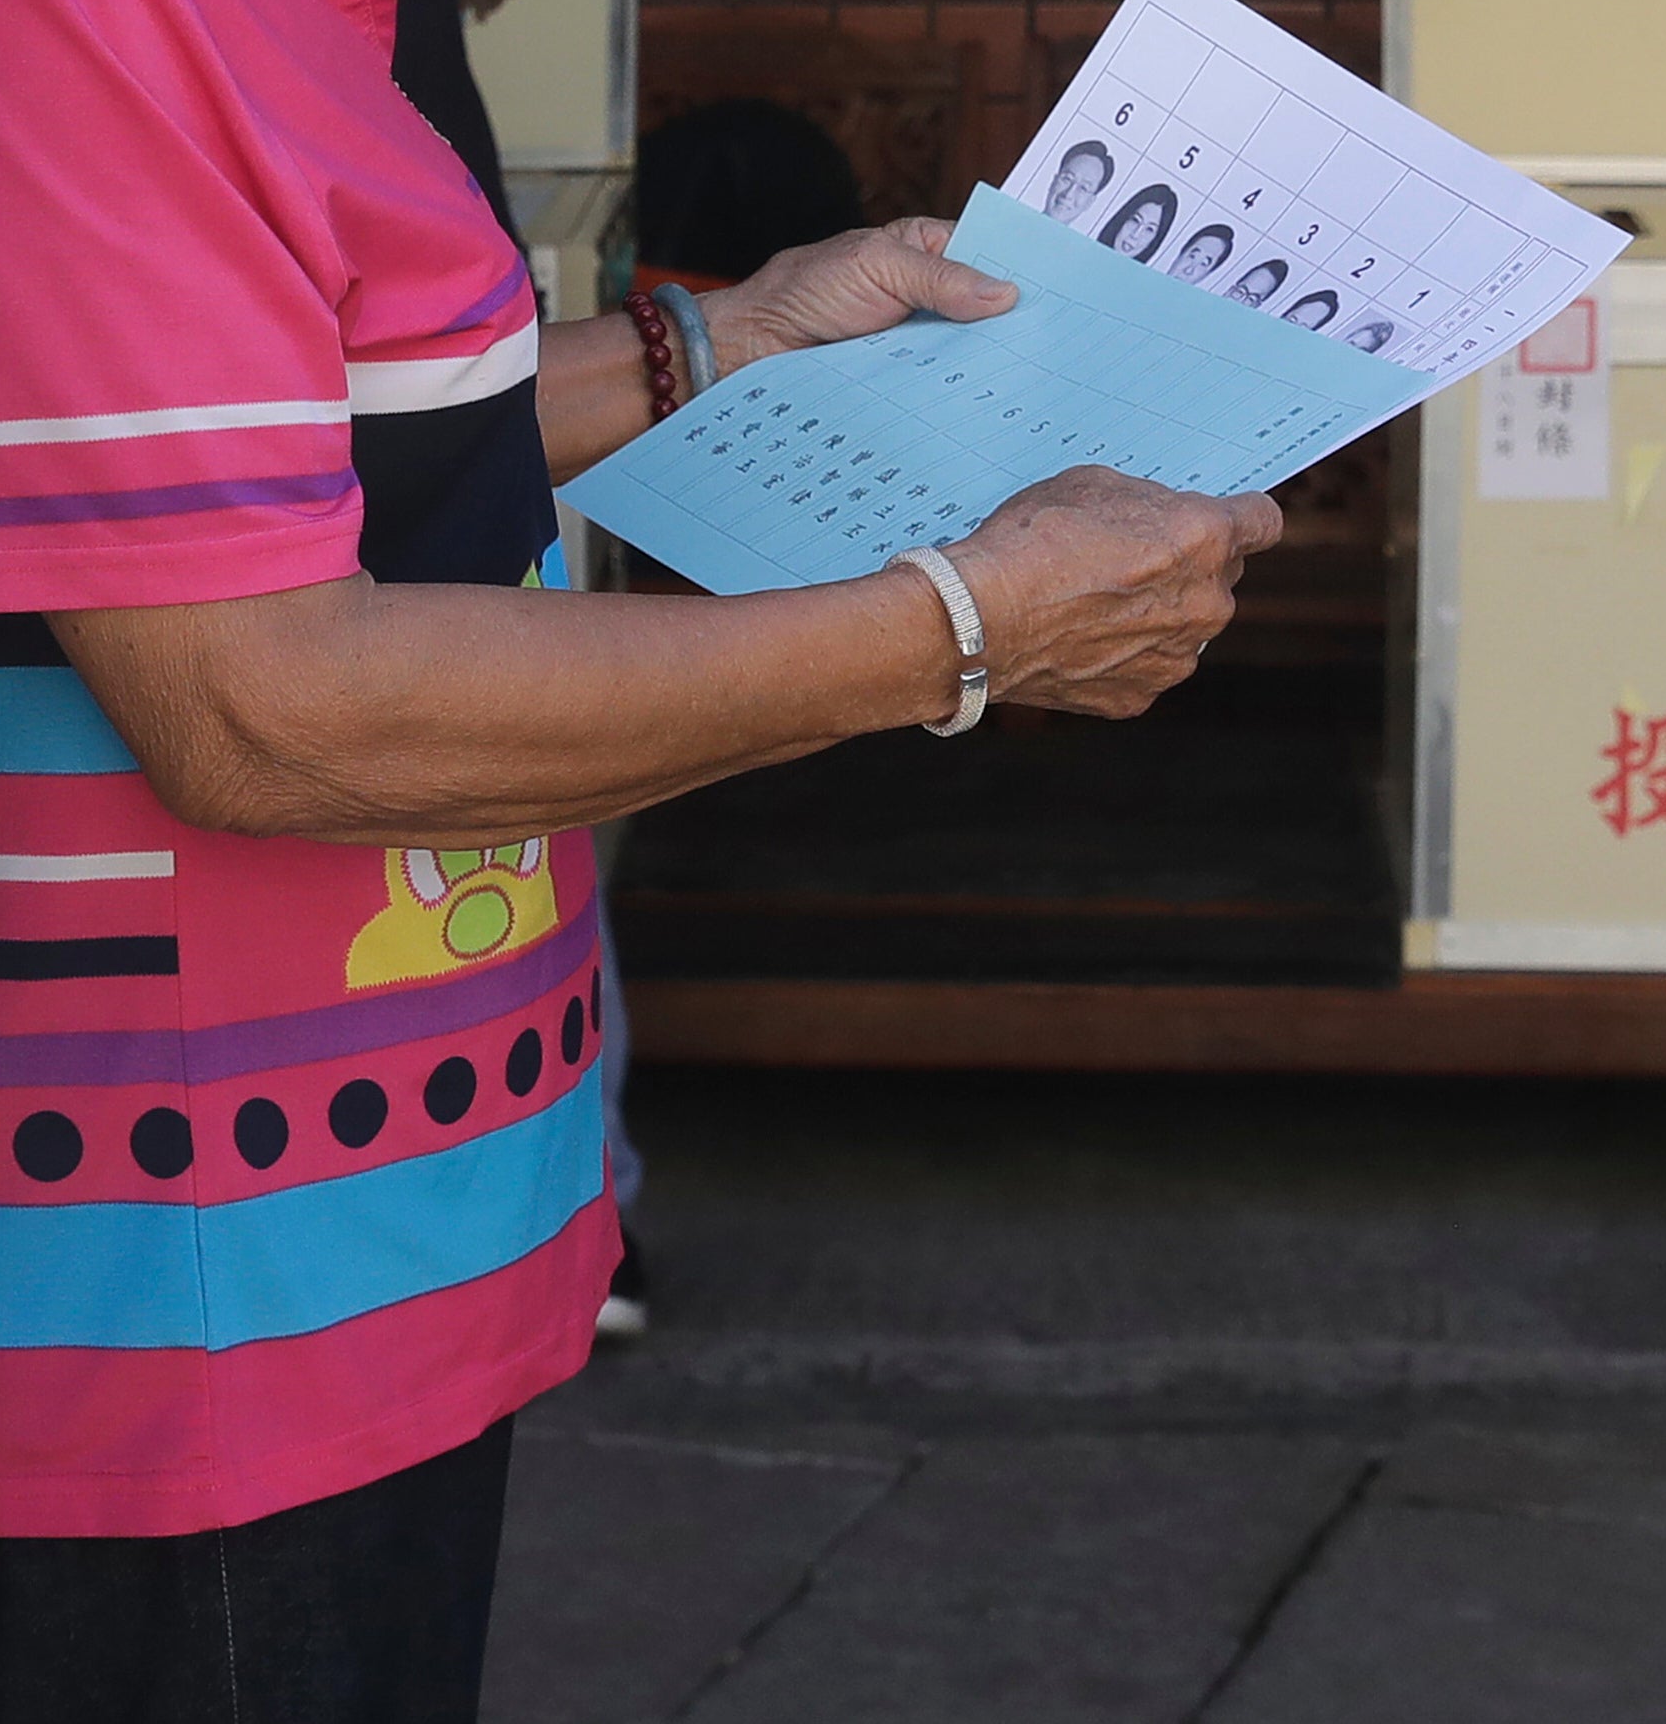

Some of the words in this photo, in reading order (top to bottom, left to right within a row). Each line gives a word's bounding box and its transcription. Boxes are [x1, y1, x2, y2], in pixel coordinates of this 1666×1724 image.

[1114, 102, 1134, 126] 6
[1179, 145, 1200, 169] 5
[1241, 188, 1263, 210] 4
[1298, 224, 1320, 245] 3
[1350, 257, 1375, 278] 2
[1407, 289, 1431, 309] 1
[915, 356, 936, 368] 9
[944, 372, 965, 385] 8
[973, 389, 995, 402] 7
[1002, 406, 1023, 420] 6
[1029, 420, 1051, 434] 5
[1060, 431, 1078, 446] 4
[1085, 442, 1106, 457] 3
[1113, 454, 1134, 469] 2
[1143, 464, 1163, 479] 1
